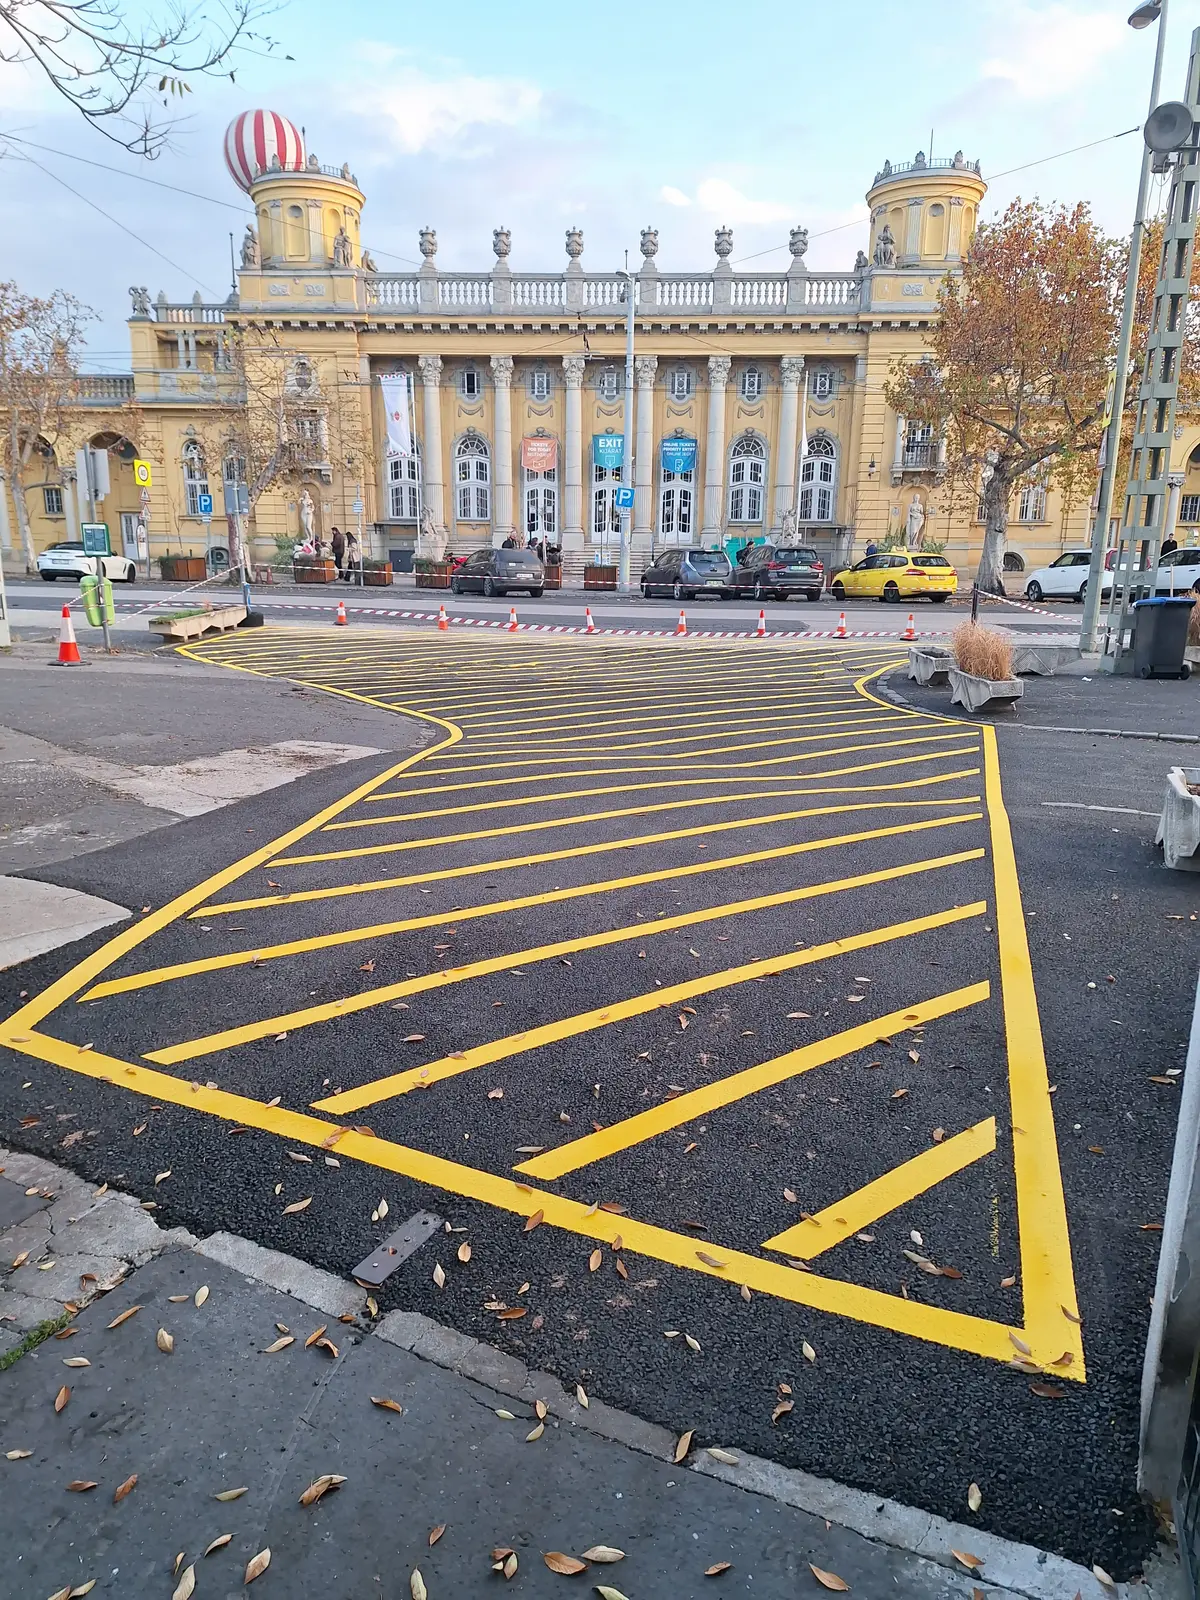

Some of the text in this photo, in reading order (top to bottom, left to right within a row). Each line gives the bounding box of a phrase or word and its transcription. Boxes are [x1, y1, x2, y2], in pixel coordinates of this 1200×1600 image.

[598, 438, 623, 448] EXIT
[200, 496, 210, 511] P
[618, 489, 632, 505] P
